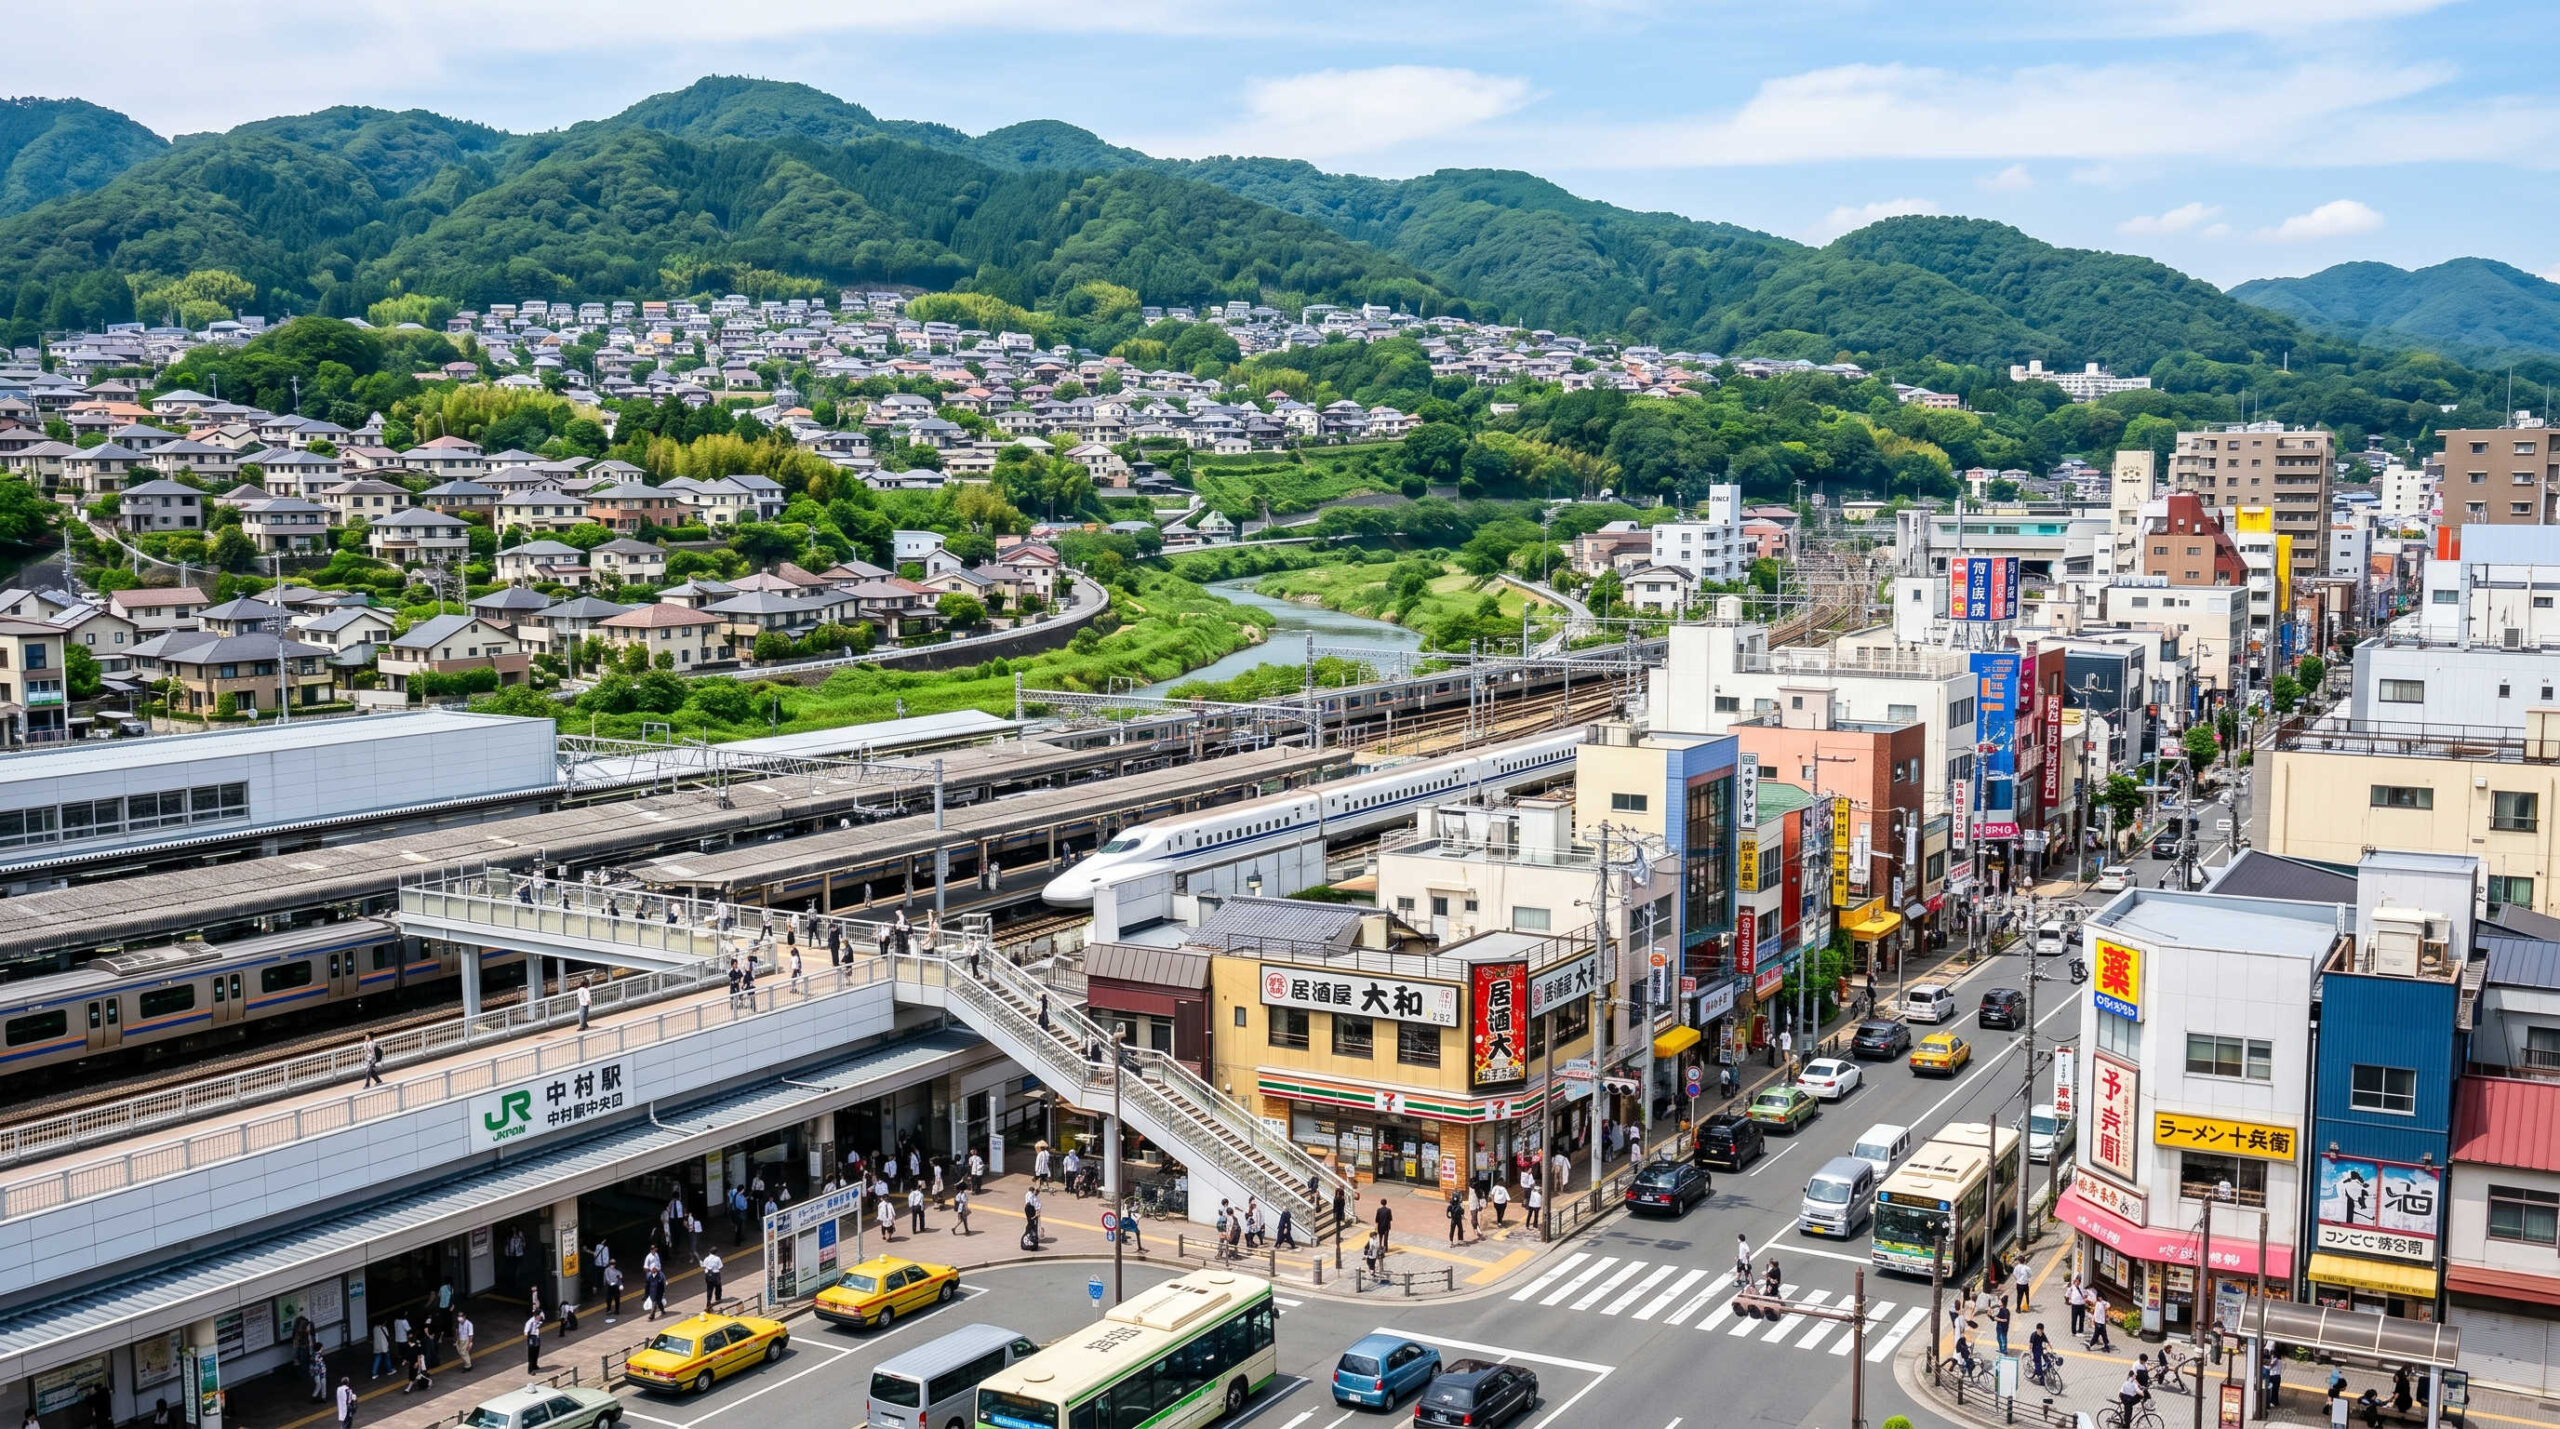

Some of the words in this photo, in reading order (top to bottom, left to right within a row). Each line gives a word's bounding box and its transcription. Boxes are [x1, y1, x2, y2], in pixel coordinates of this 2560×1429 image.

[2102, 946, 2131, 997] 薬
[1291, 978, 1352, 1006] 居酒屋
[1360, 982, 1423, 1018] 大和
[546, 1063, 622, 1107] 中村駅
[1383, 1092, 1395, 1112] 7
[484, 1089, 532, 1131] JR
[1492, 1100, 1505, 1119] 7
